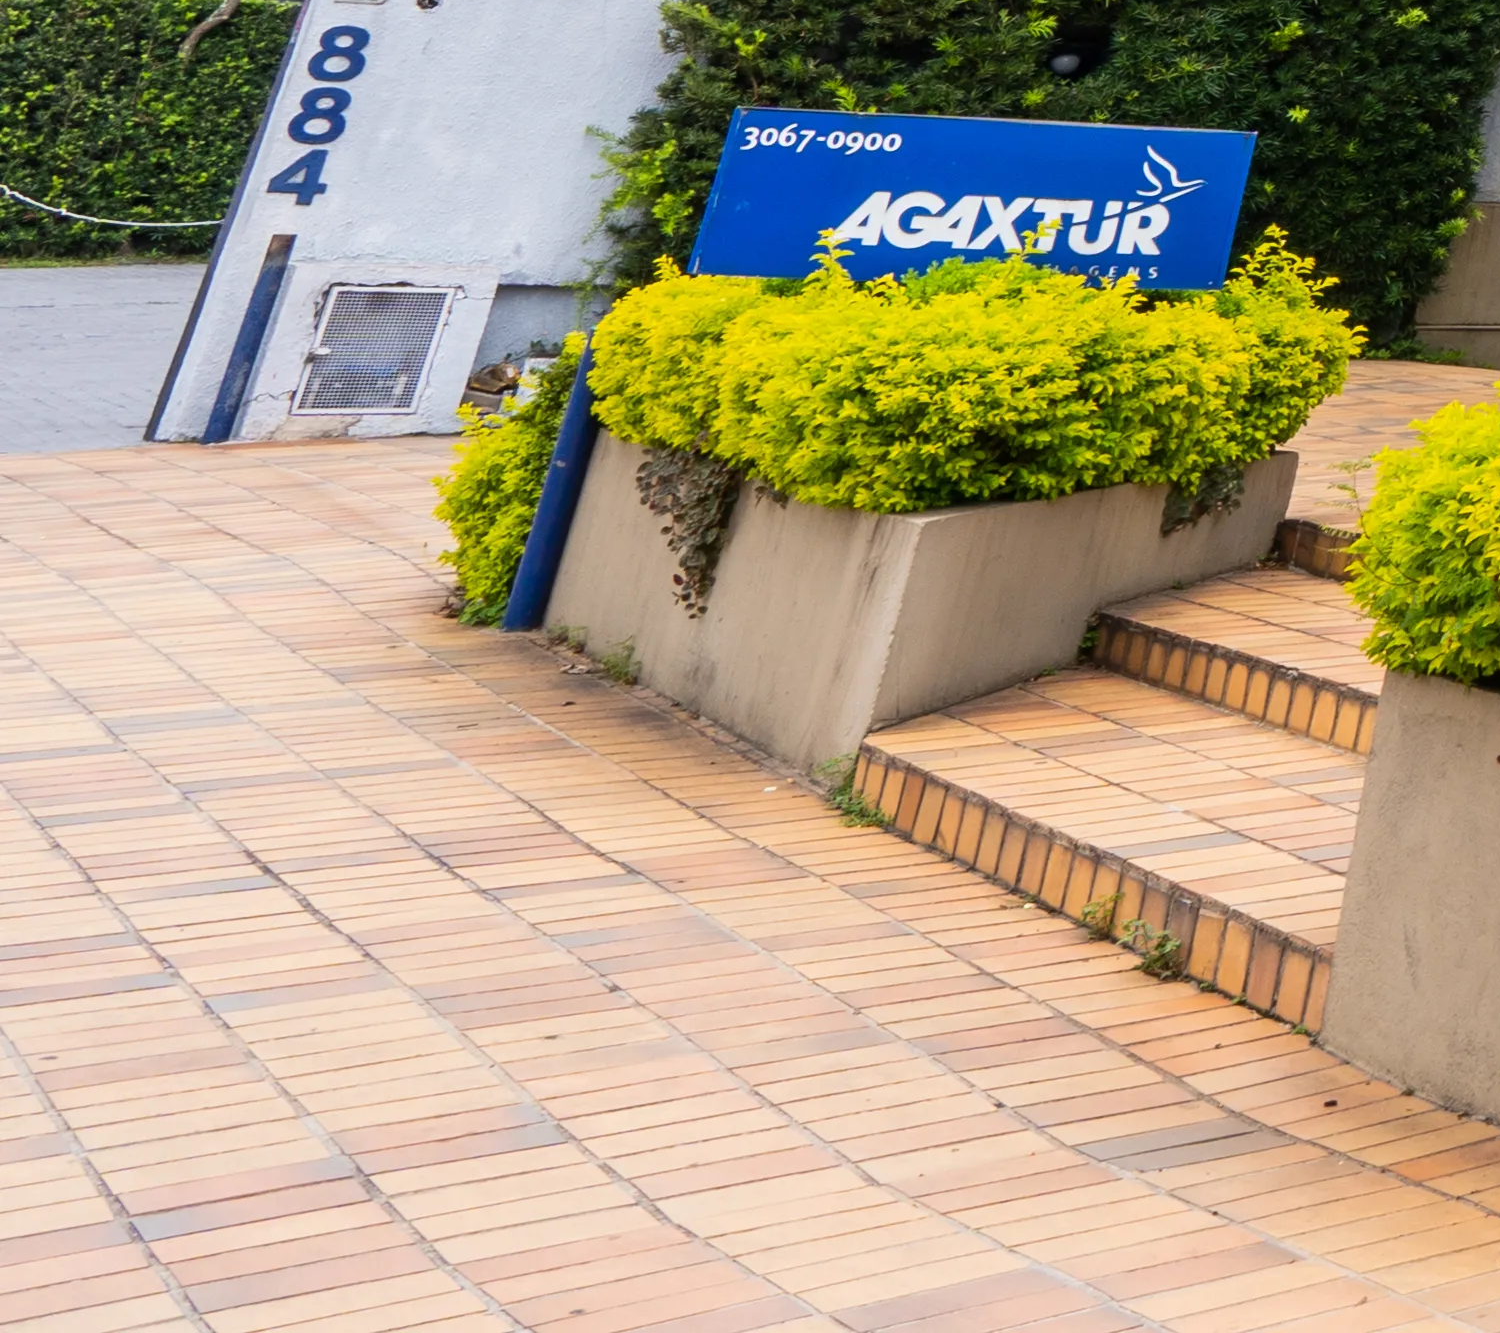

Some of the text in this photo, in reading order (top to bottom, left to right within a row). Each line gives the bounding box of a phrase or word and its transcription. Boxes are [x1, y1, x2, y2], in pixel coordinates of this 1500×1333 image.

[267, 25, 371, 206] 884
[740, 124, 903, 154] 3067-0900
[832, 189, 1171, 256] AGAXTUR
